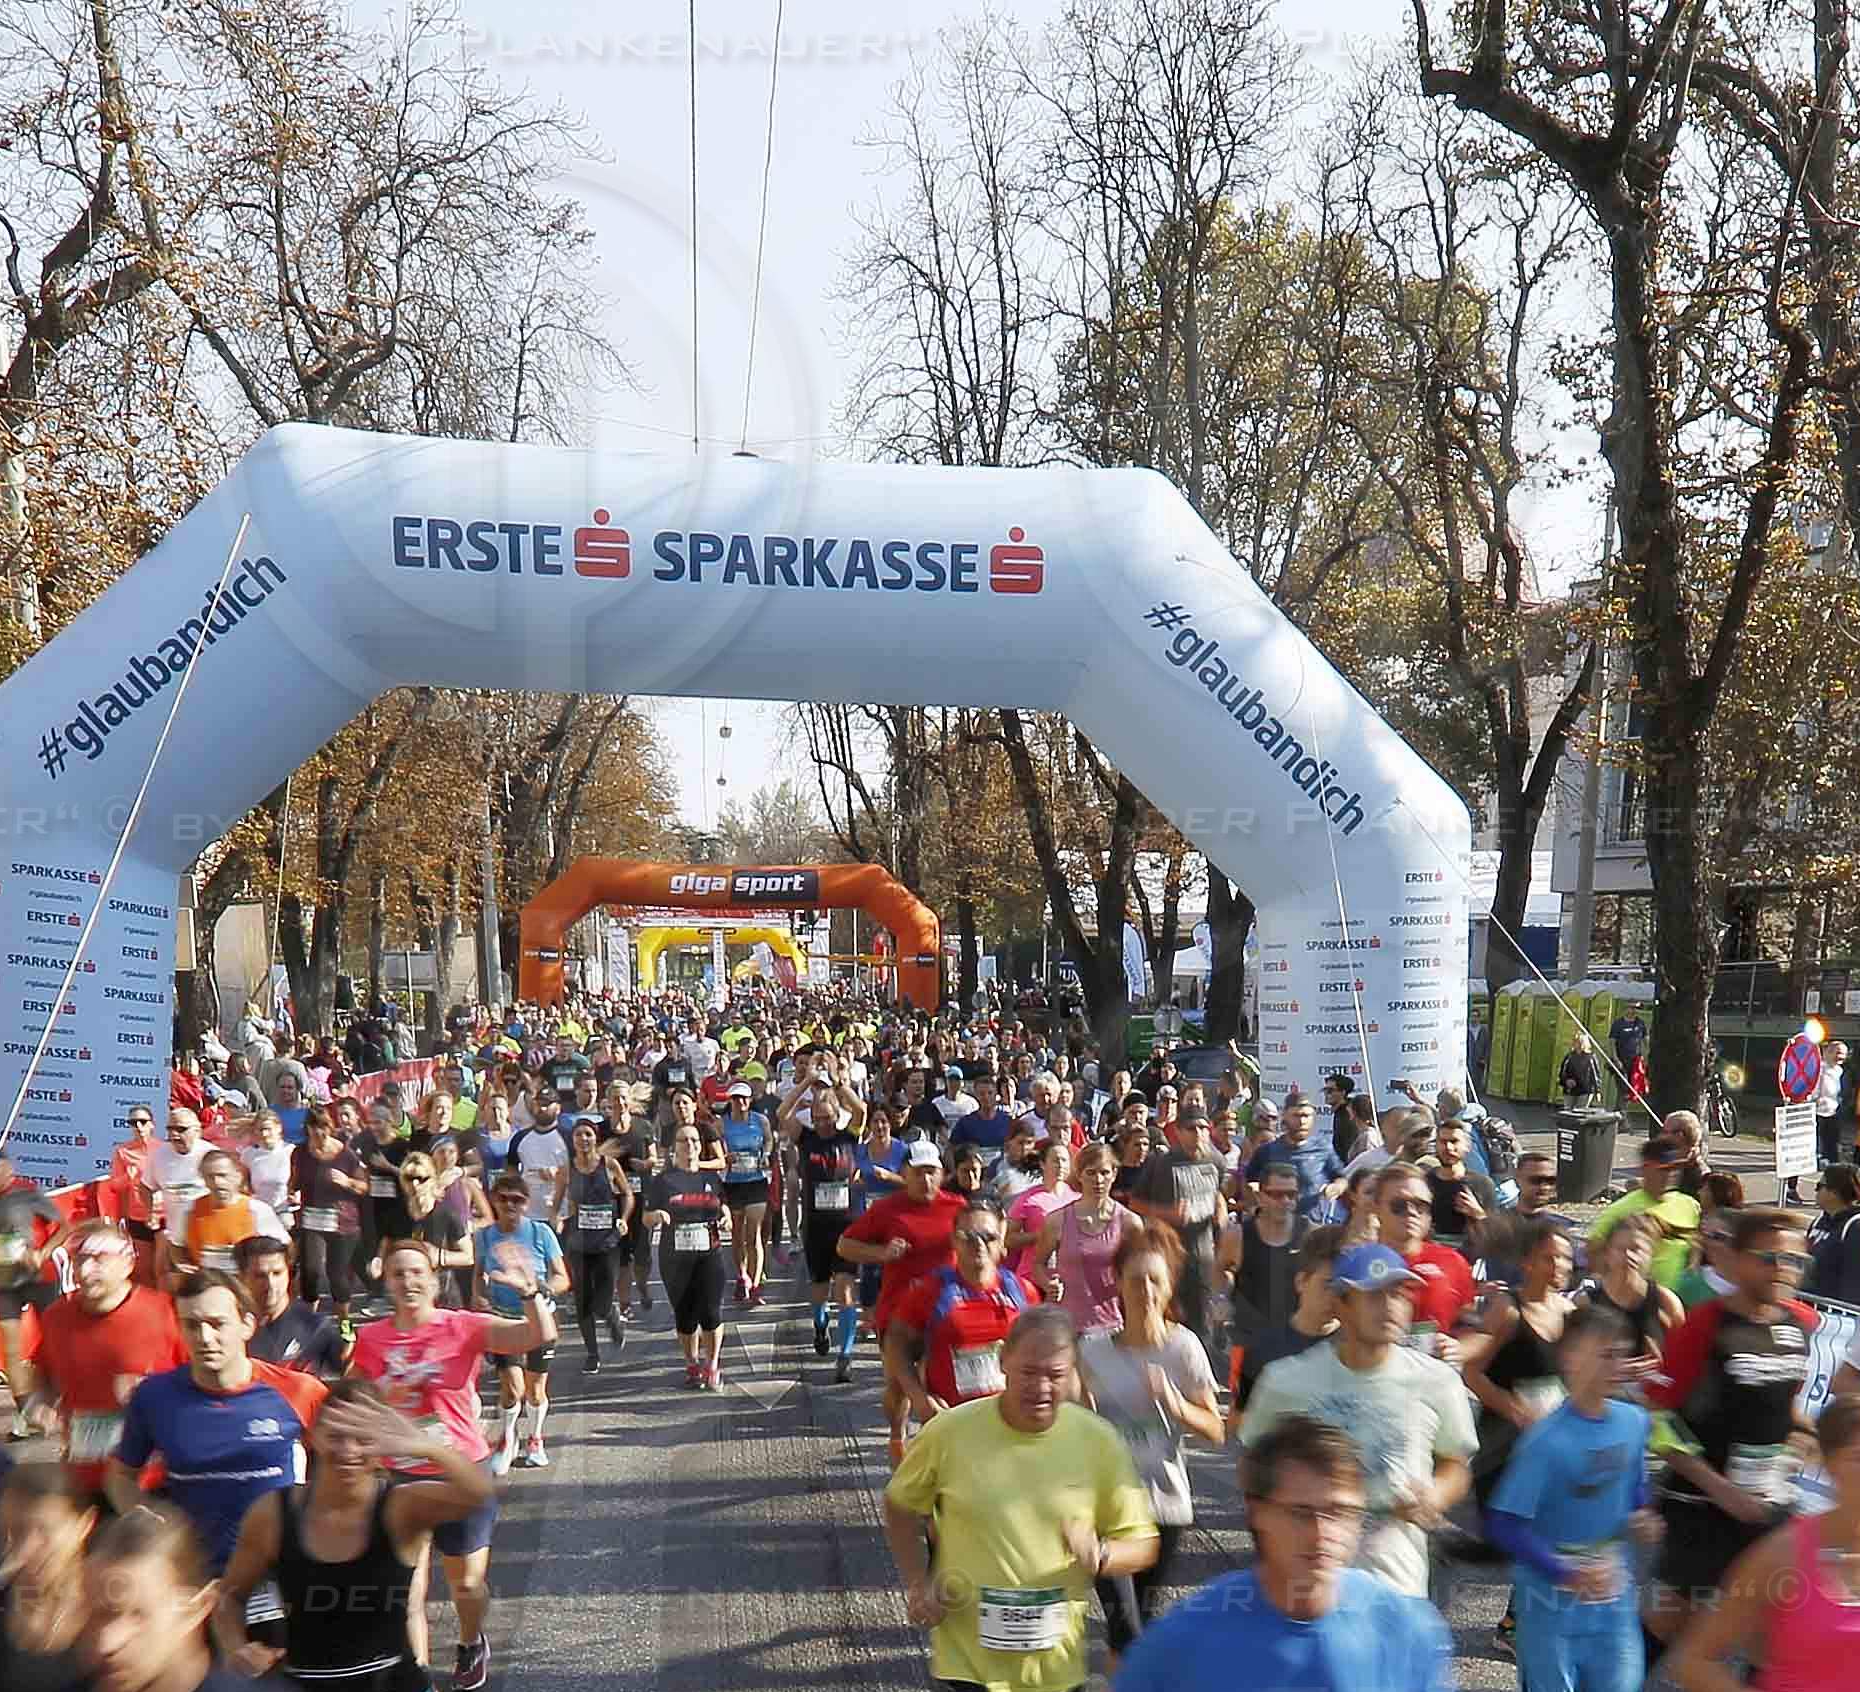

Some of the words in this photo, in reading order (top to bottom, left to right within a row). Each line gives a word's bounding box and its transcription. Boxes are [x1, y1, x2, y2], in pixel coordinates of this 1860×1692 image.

[393, 516, 563, 576] ERSTE
[653, 531, 979, 592] SPARKASSE
[38, 555, 287, 779] #glaubandich
[1143, 602, 1364, 836] #glaubandich
[11, 863, 87, 883] SPARKASSE
[1406, 872, 1433, 883] ERSTE
[669, 872, 727, 894] giga
[733, 872, 805, 897] sport
[27, 911, 66, 926] ERSTE
[1390, 915, 1444, 927] SPARKASSE
[1305, 939, 1368, 950] SPARKASSE
[122, 945, 150, 961] ERSTE
[7, 954, 83, 973] SPARKASSE
[1403, 958, 1431, 969] ERSTE
[1320, 981, 1350, 993] ERSTE
[1388, 1000, 1440, 1012] SPARKASSE
[117, 1032, 147, 1046] ERSTE
[1401, 1042, 1430, 1053] ERSTE
